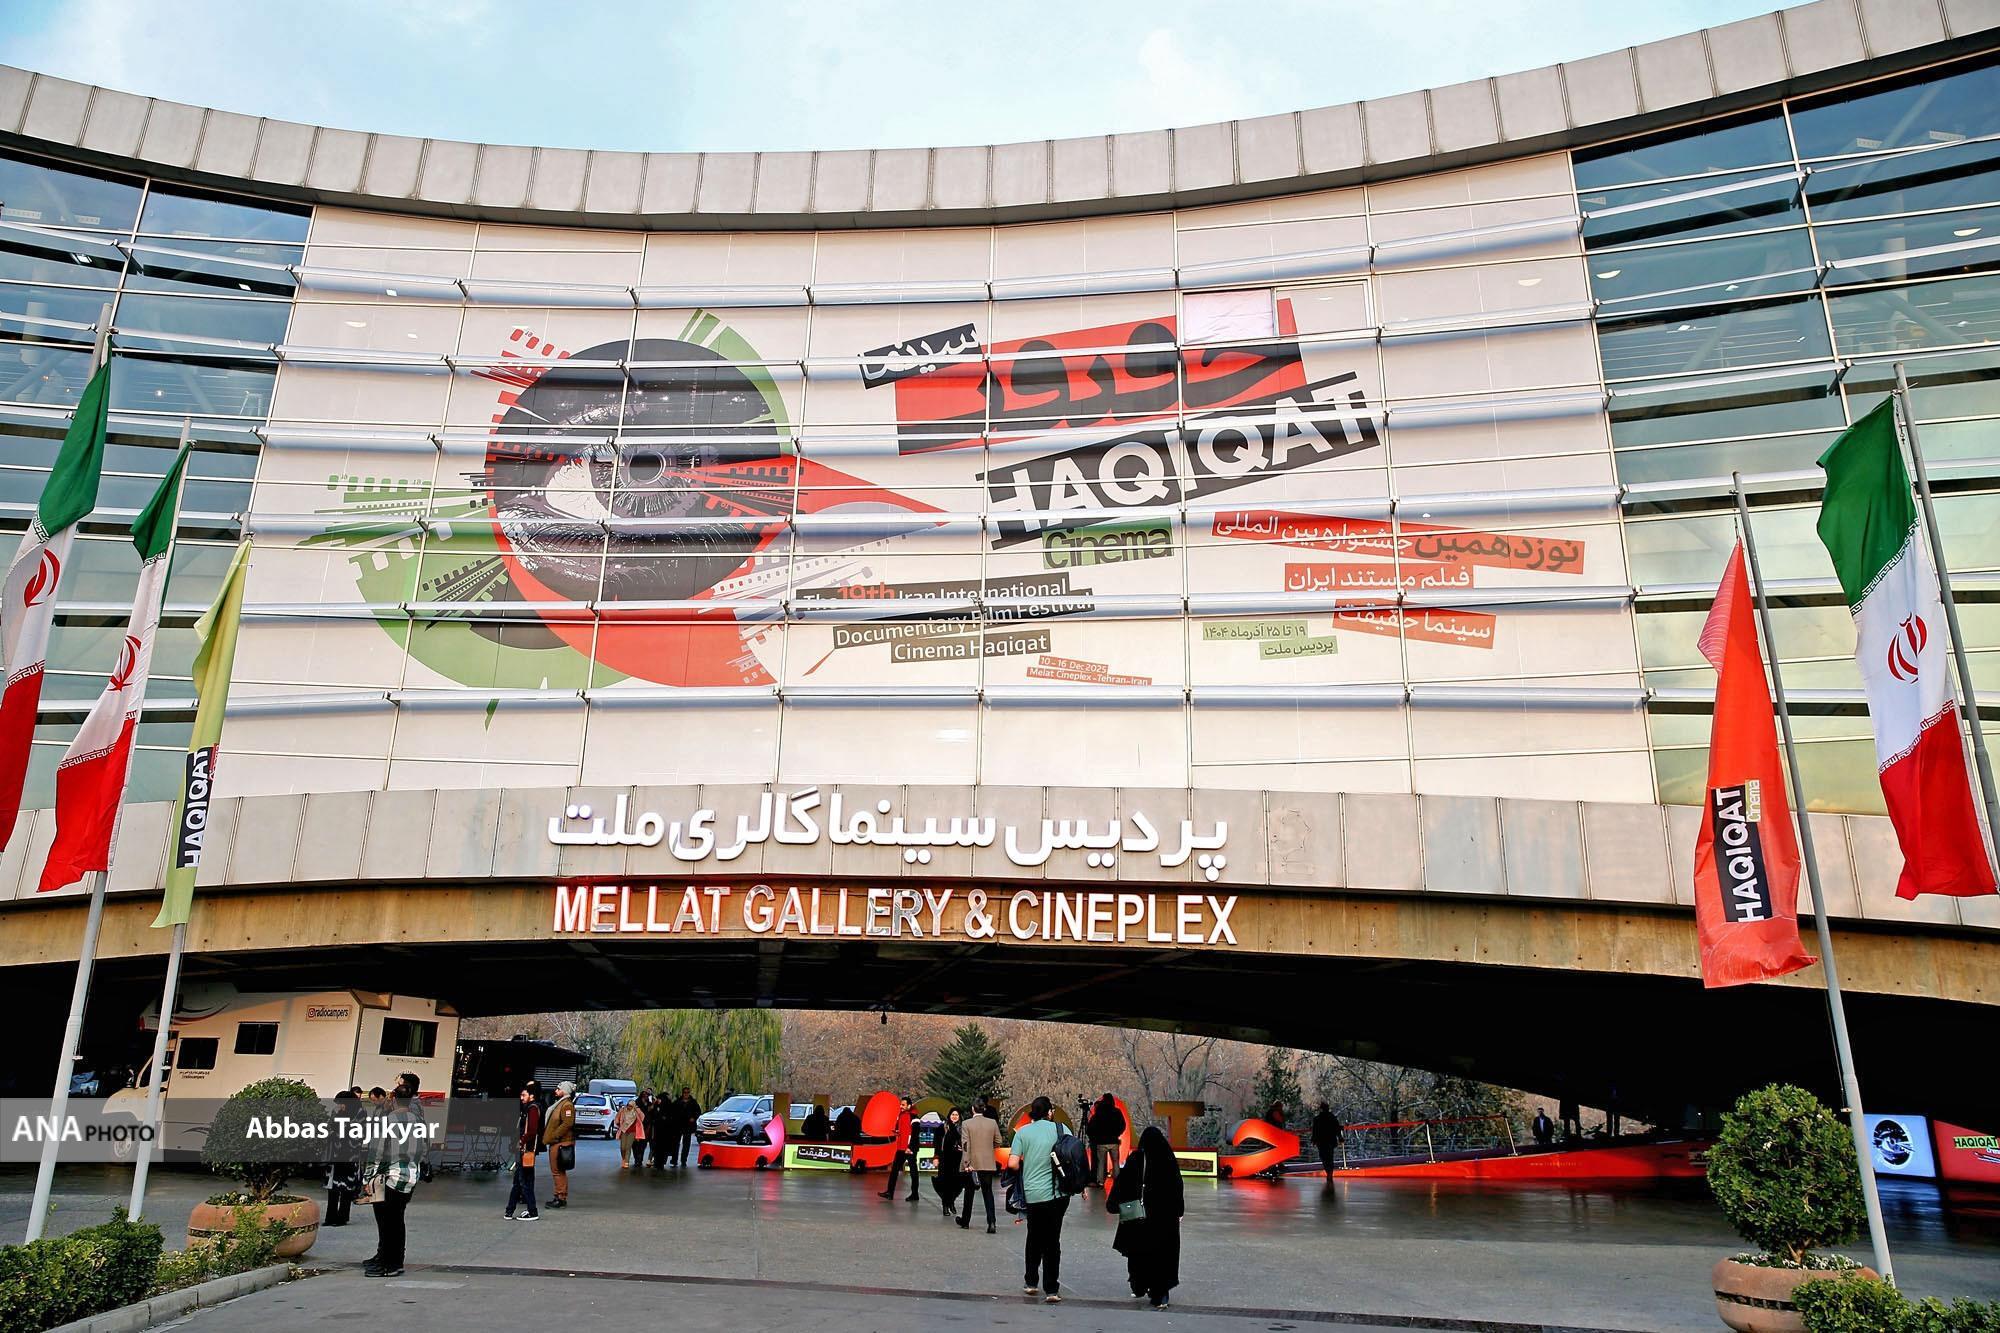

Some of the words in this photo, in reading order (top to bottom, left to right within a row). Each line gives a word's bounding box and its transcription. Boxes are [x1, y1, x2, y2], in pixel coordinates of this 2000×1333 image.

[990, 378, 1364, 533] HAQIQAT
[1215, 512, 1279, 535] المللی
[1281, 525, 1319, 548] بین
[1323, 523, 1413, 555] جشنواره
[1045, 527, 1171, 569] Cinema
[1414, 533, 1579, 572] نوزدهمین
[837, 581, 894, 602] 19th
[1288, 567, 1336, 591] ایران
[1340, 569, 1416, 588] مستند
[836, 616, 967, 646] Documentary
[1338, 602, 1419, 631] حقیقت
[1424, 611, 1491, 642] سینما
[894, 643, 964, 660] Cinema
[970, 634, 1047, 657] Haqiqat
[1264, 643, 1292, 656] ملت
[1293, 640, 1334, 655] پردیس
[184, 749, 208, 868] HAQIQAT
[548, 794, 665, 846] ملت
[668, 785, 821, 861] گالری
[828, 792, 997, 865] سینما
[1005, 810, 1228, 882] پردیس
[1715, 786, 1765, 922] HAQIQAT
[553, 885, 731, 934] MELLAT
[743, 884, 954, 938] GALLERY
[964, 888, 996, 939] &
[1008, 888, 1238, 945] CINEPLEX
[1954, 1136, 1998, 1148] HAQIQAT
